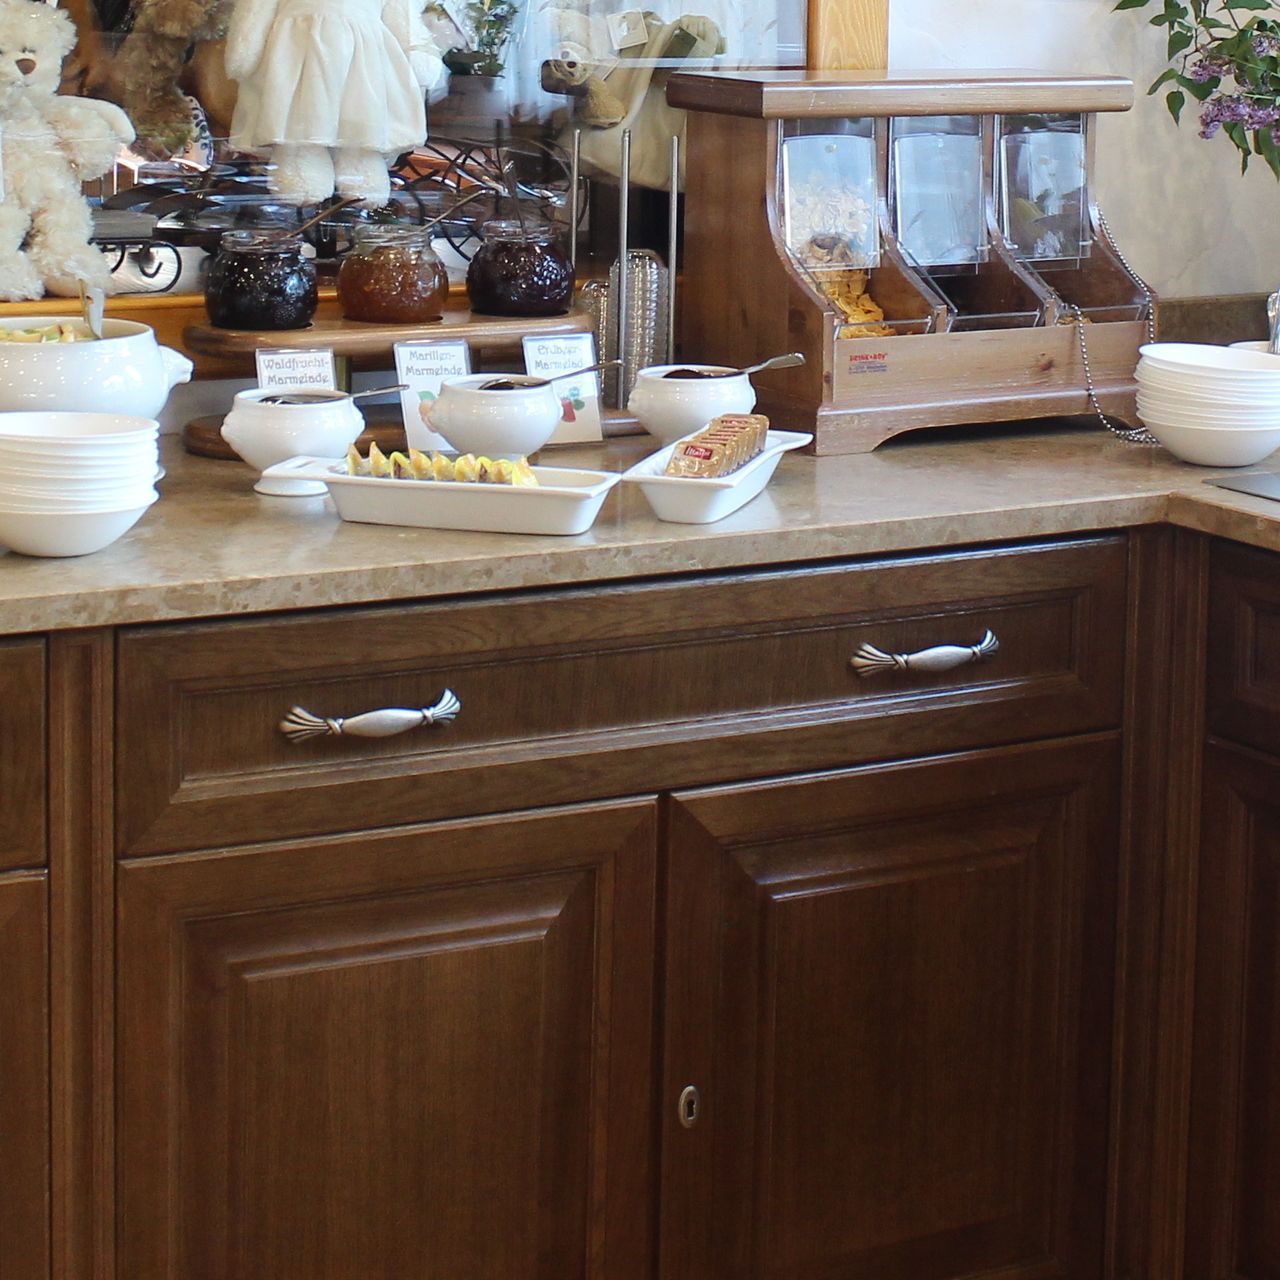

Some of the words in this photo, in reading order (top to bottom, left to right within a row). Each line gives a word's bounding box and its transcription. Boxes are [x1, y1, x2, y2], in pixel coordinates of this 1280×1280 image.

[409, 350, 456, 362] Marillen-
[405, 364, 463, 376] Marmelade
[535, 359, 584, 370] Marmelad
[267, 371, 329, 386] Marmelade
